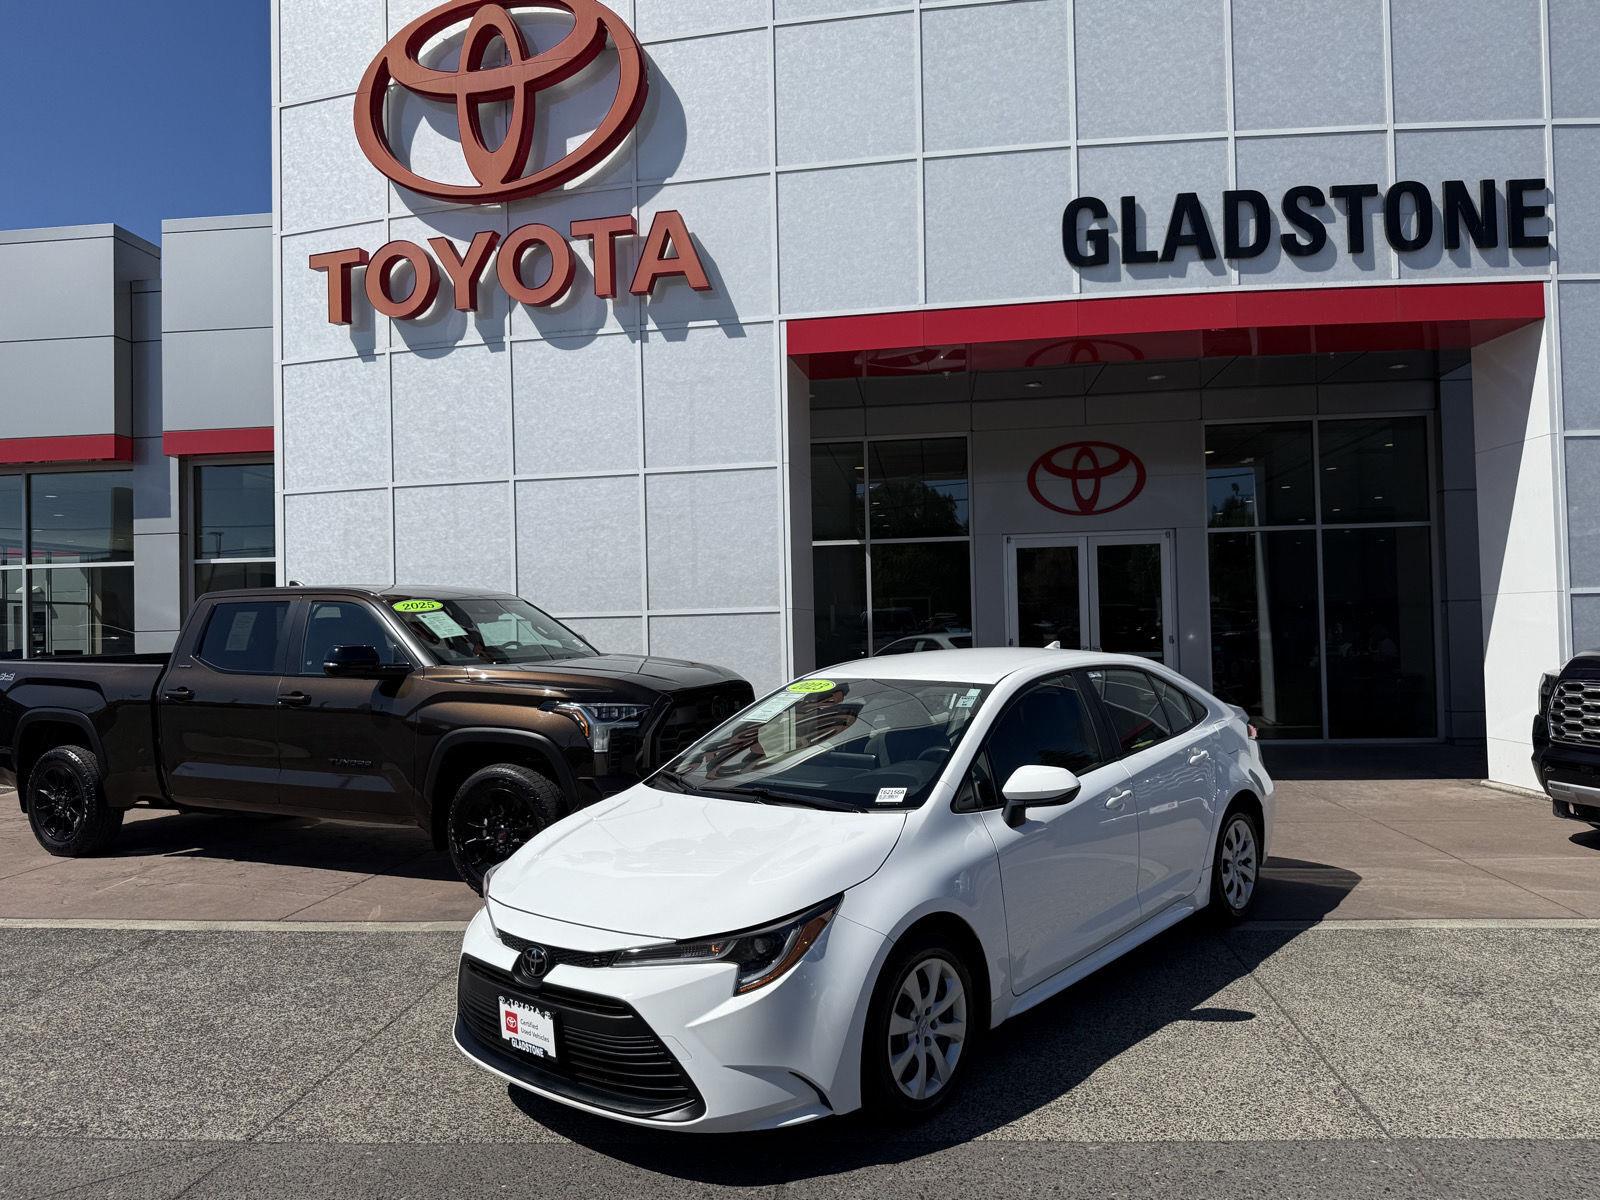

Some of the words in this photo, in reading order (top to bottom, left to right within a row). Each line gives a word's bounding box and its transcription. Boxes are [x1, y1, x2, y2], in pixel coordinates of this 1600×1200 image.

[1062, 178, 1550, 267] GLADSTONE
[309, 209, 713, 326] TOYOTA
[402, 601, 435, 611] 2025
[512, 1038, 544, 1057] GLADSTONE
